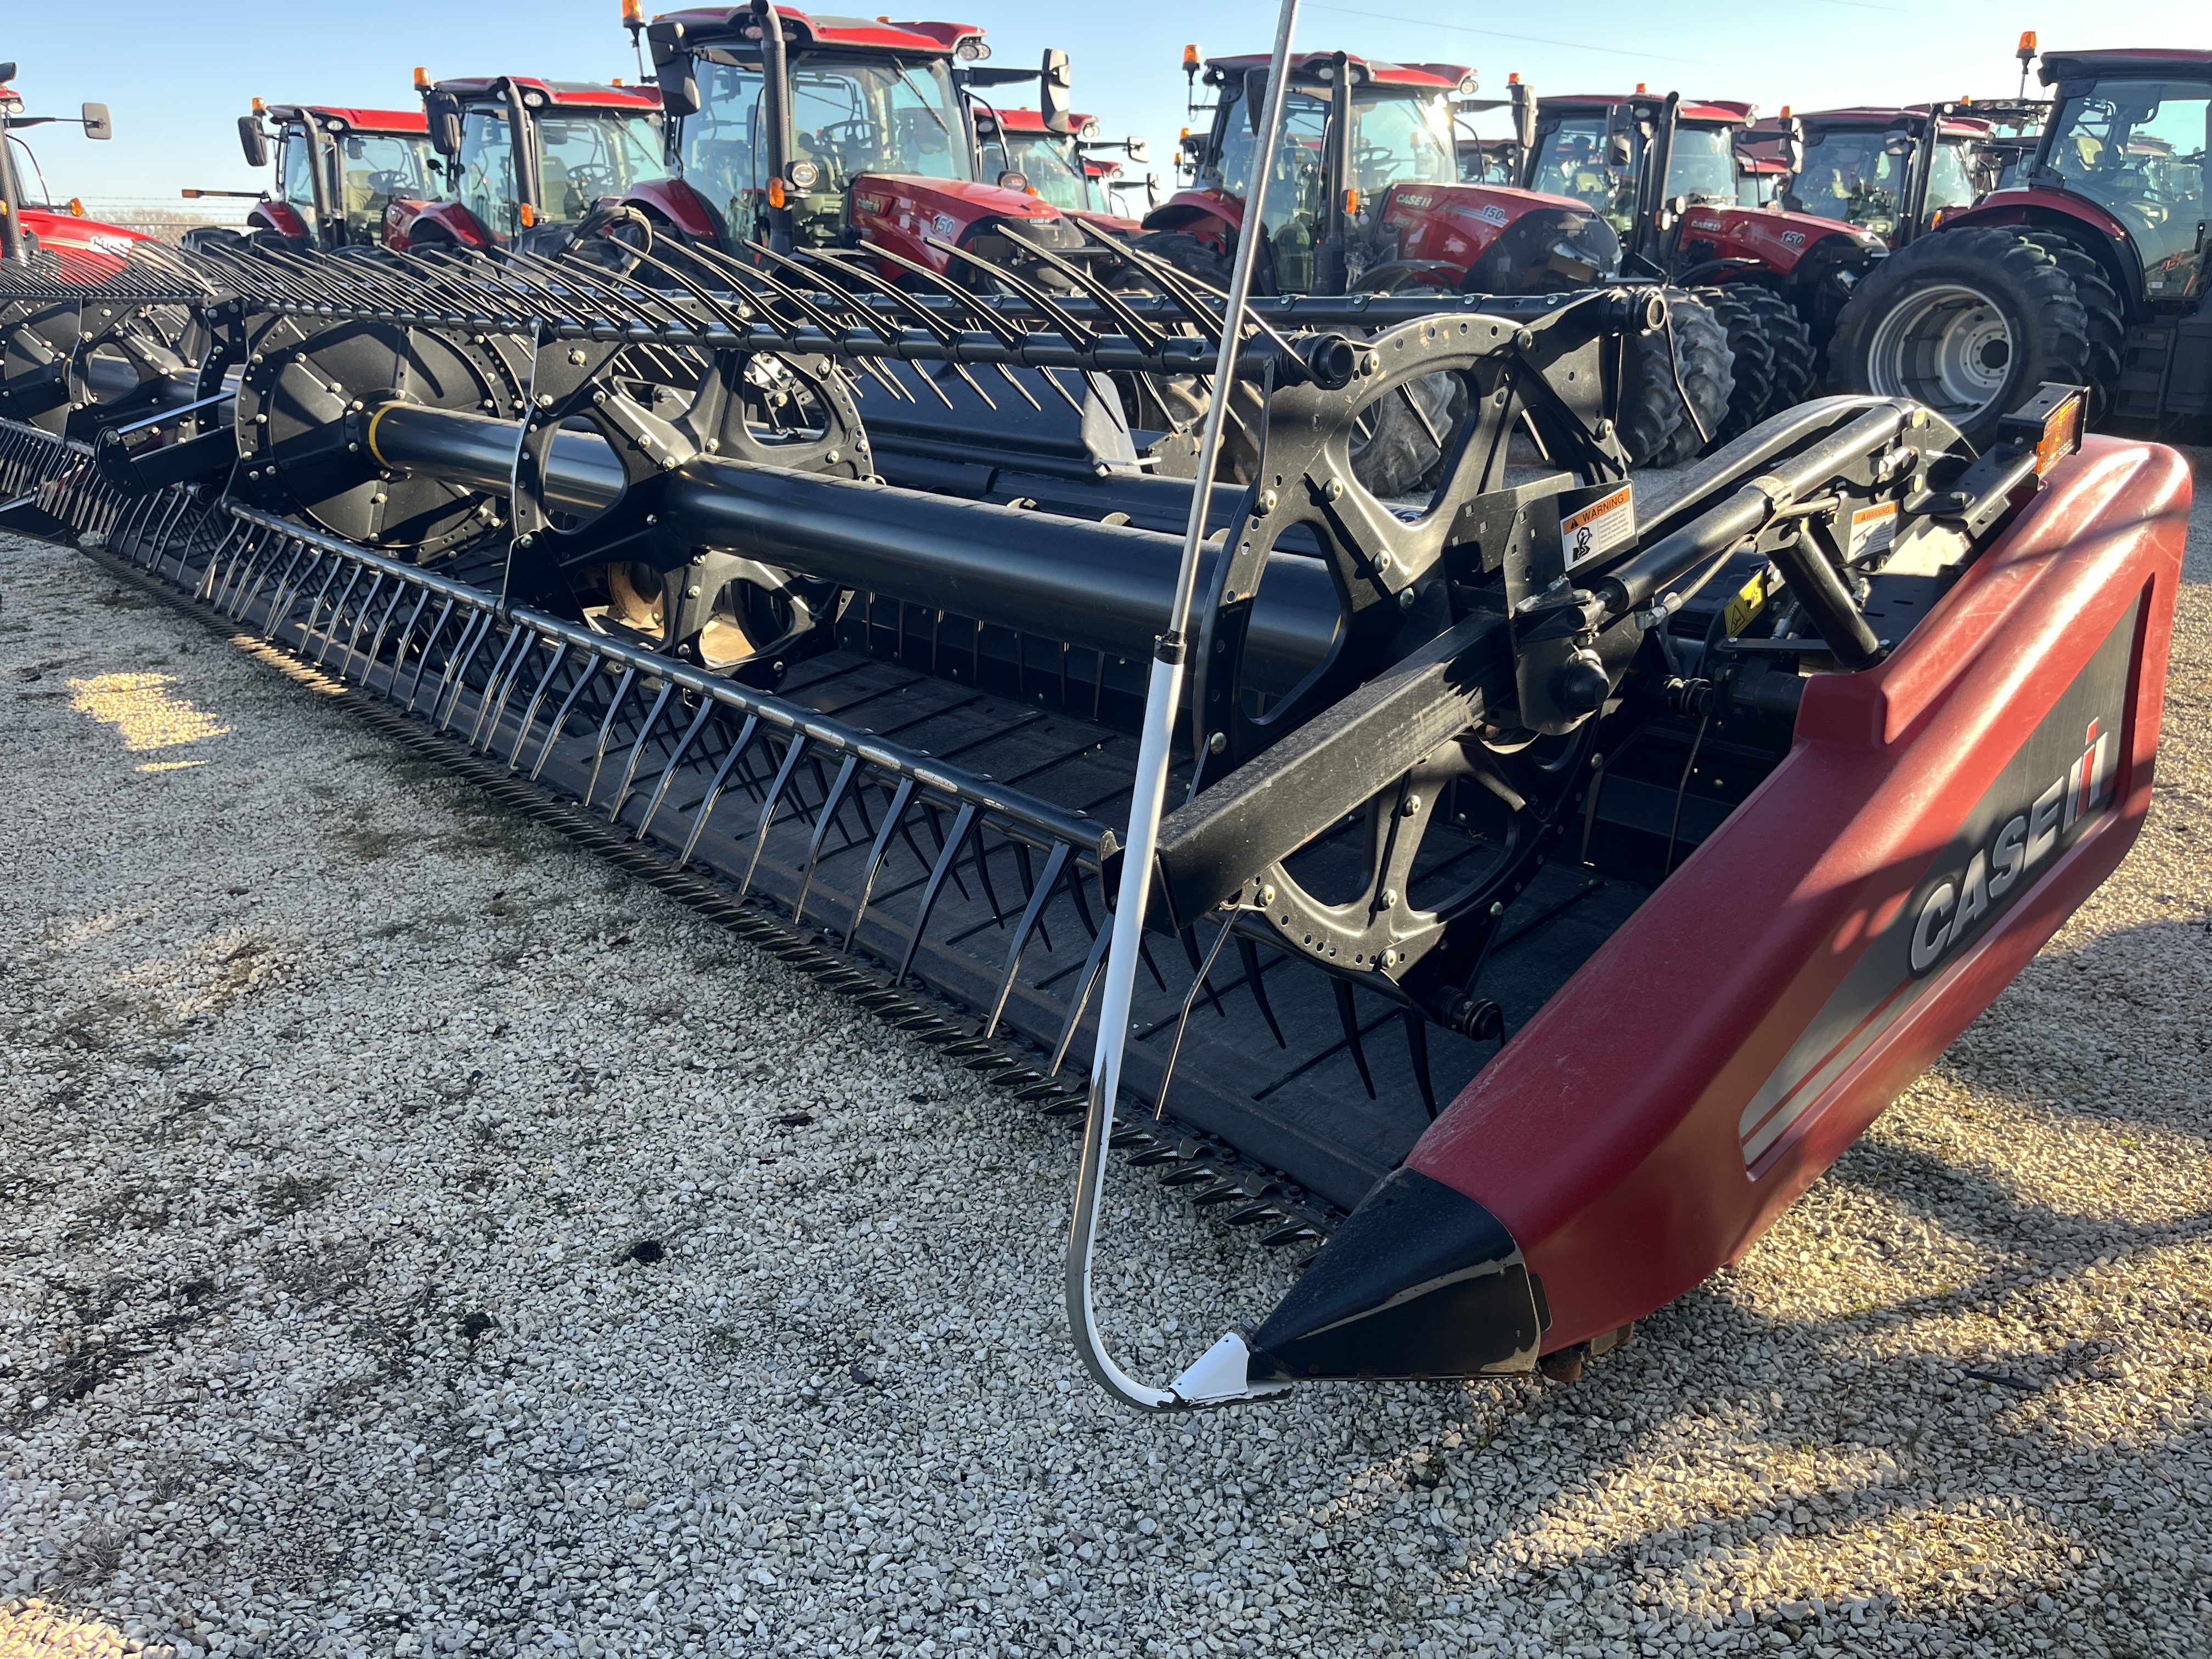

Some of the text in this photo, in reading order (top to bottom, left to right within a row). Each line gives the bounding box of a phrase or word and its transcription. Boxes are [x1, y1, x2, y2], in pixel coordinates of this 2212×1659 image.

[1483, 205, 1504, 220] 150
[933, 215, 955, 236] 150
[1782, 231, 1805, 245] 150
[1582, 494, 1624, 522] WARNING
[1867, 506, 1889, 519] WARNING
